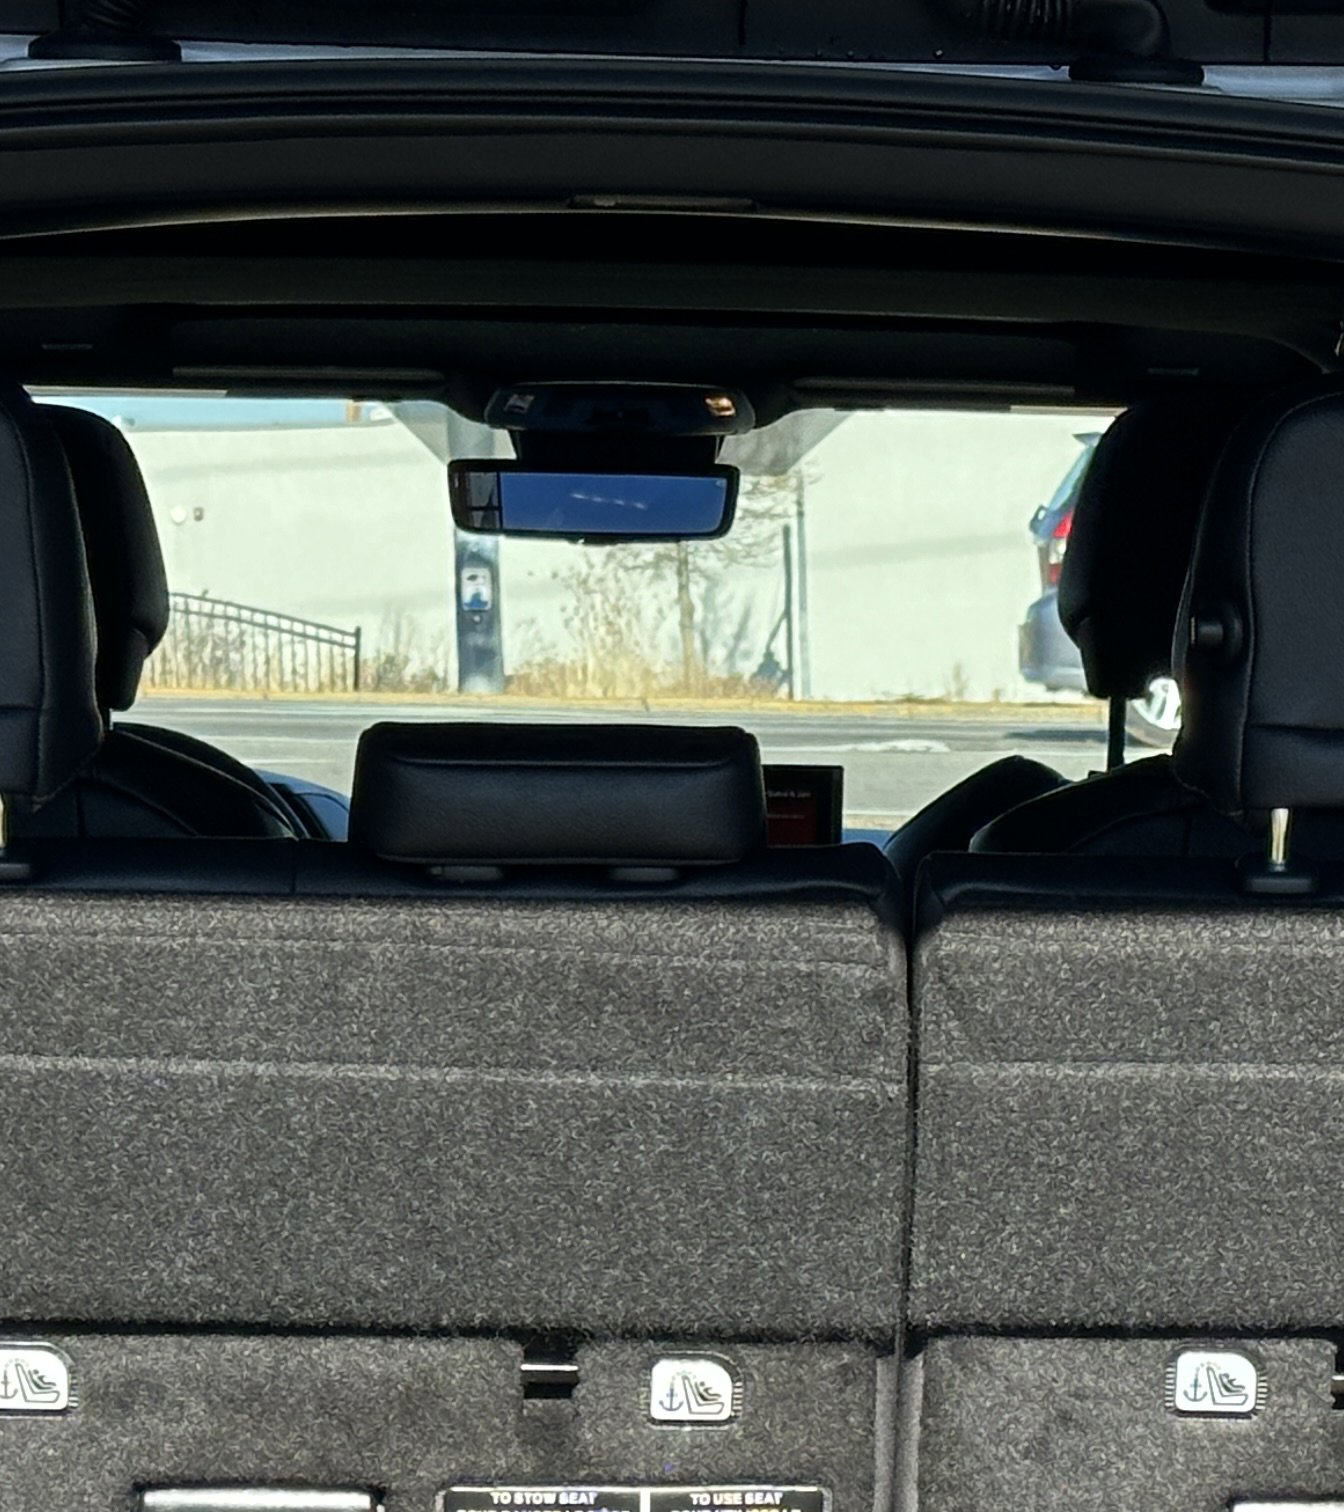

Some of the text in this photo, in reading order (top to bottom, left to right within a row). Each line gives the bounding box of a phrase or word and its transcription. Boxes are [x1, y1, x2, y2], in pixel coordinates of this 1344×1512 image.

[490, 1491, 598, 1505] TO STOW SEAT
[689, 1492, 783, 1505] TO USE SEAT
